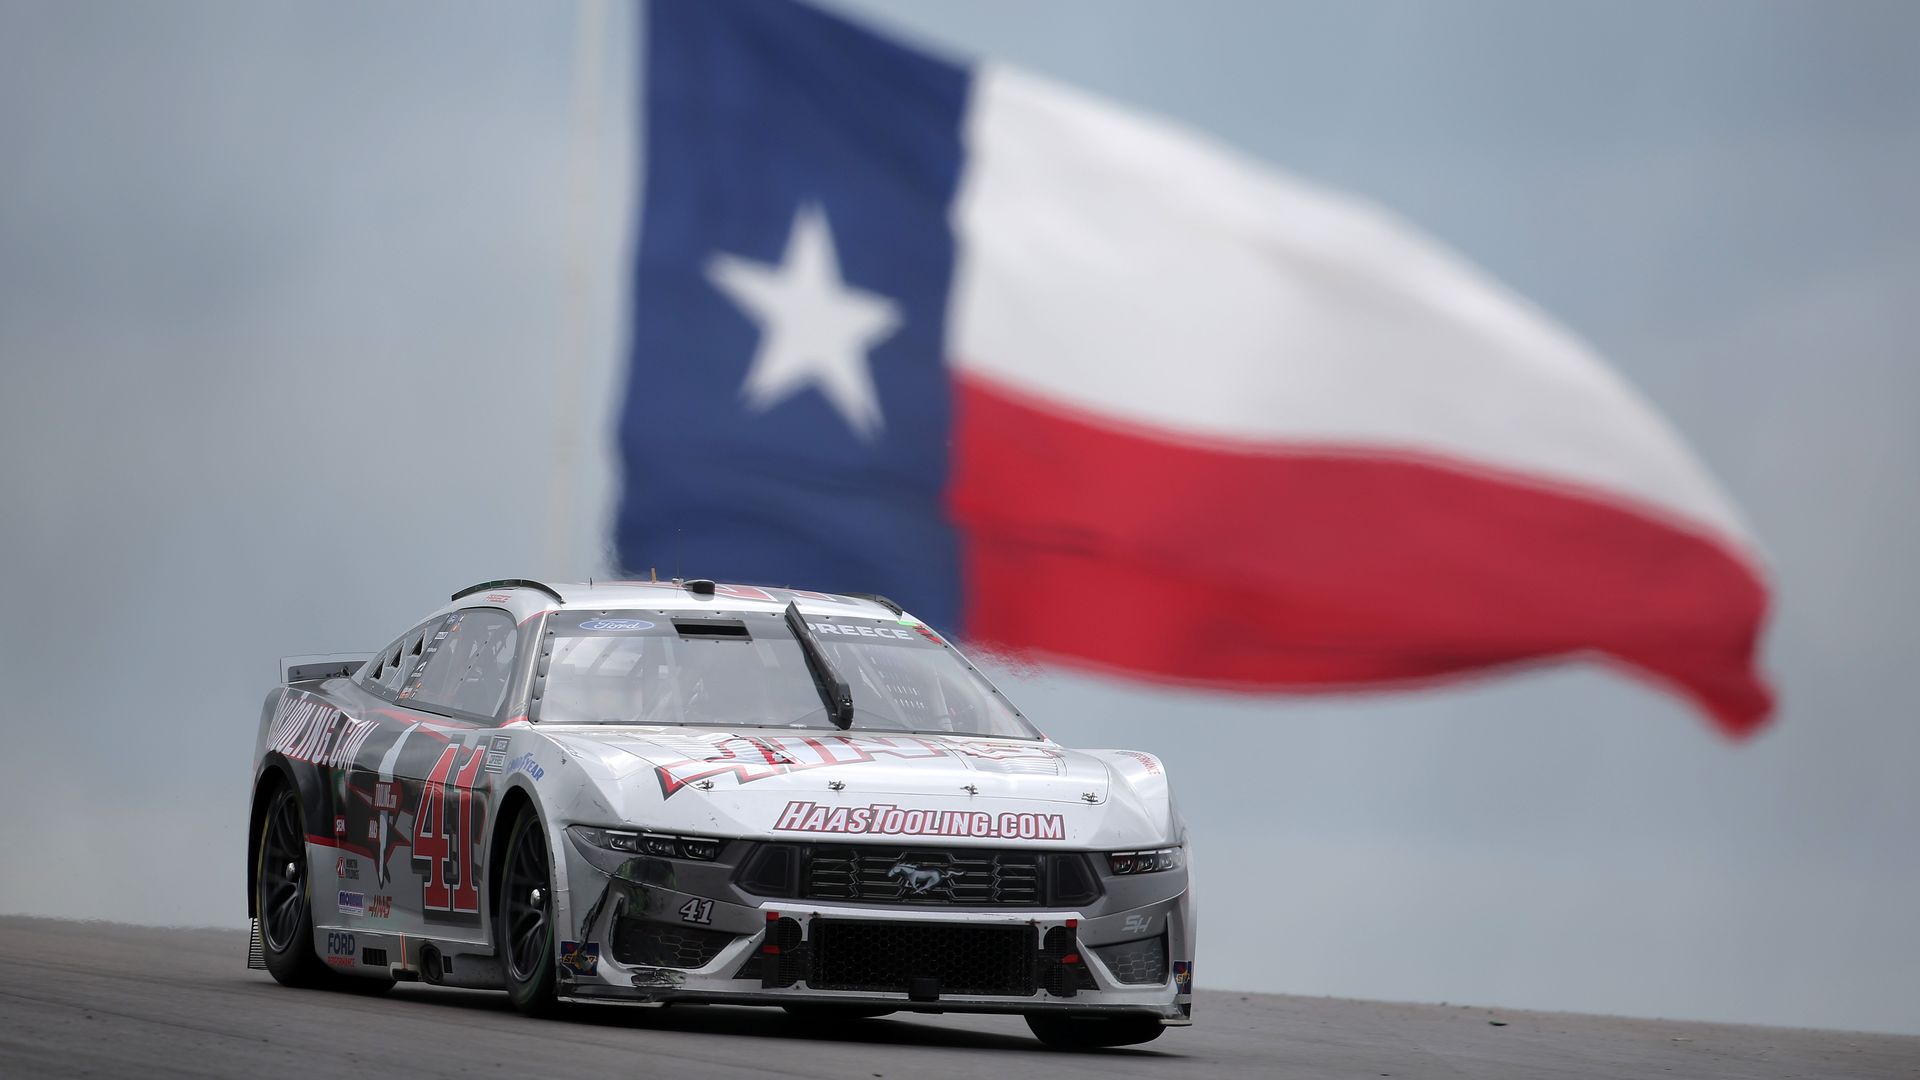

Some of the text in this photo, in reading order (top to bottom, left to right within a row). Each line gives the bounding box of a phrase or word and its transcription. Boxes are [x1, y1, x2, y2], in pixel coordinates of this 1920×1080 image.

[806, 623, 914, 640] PREECE
[412, 743, 486, 913] 41
[679, 898, 714, 925] 41
[327, 932, 356, 956] FORD
